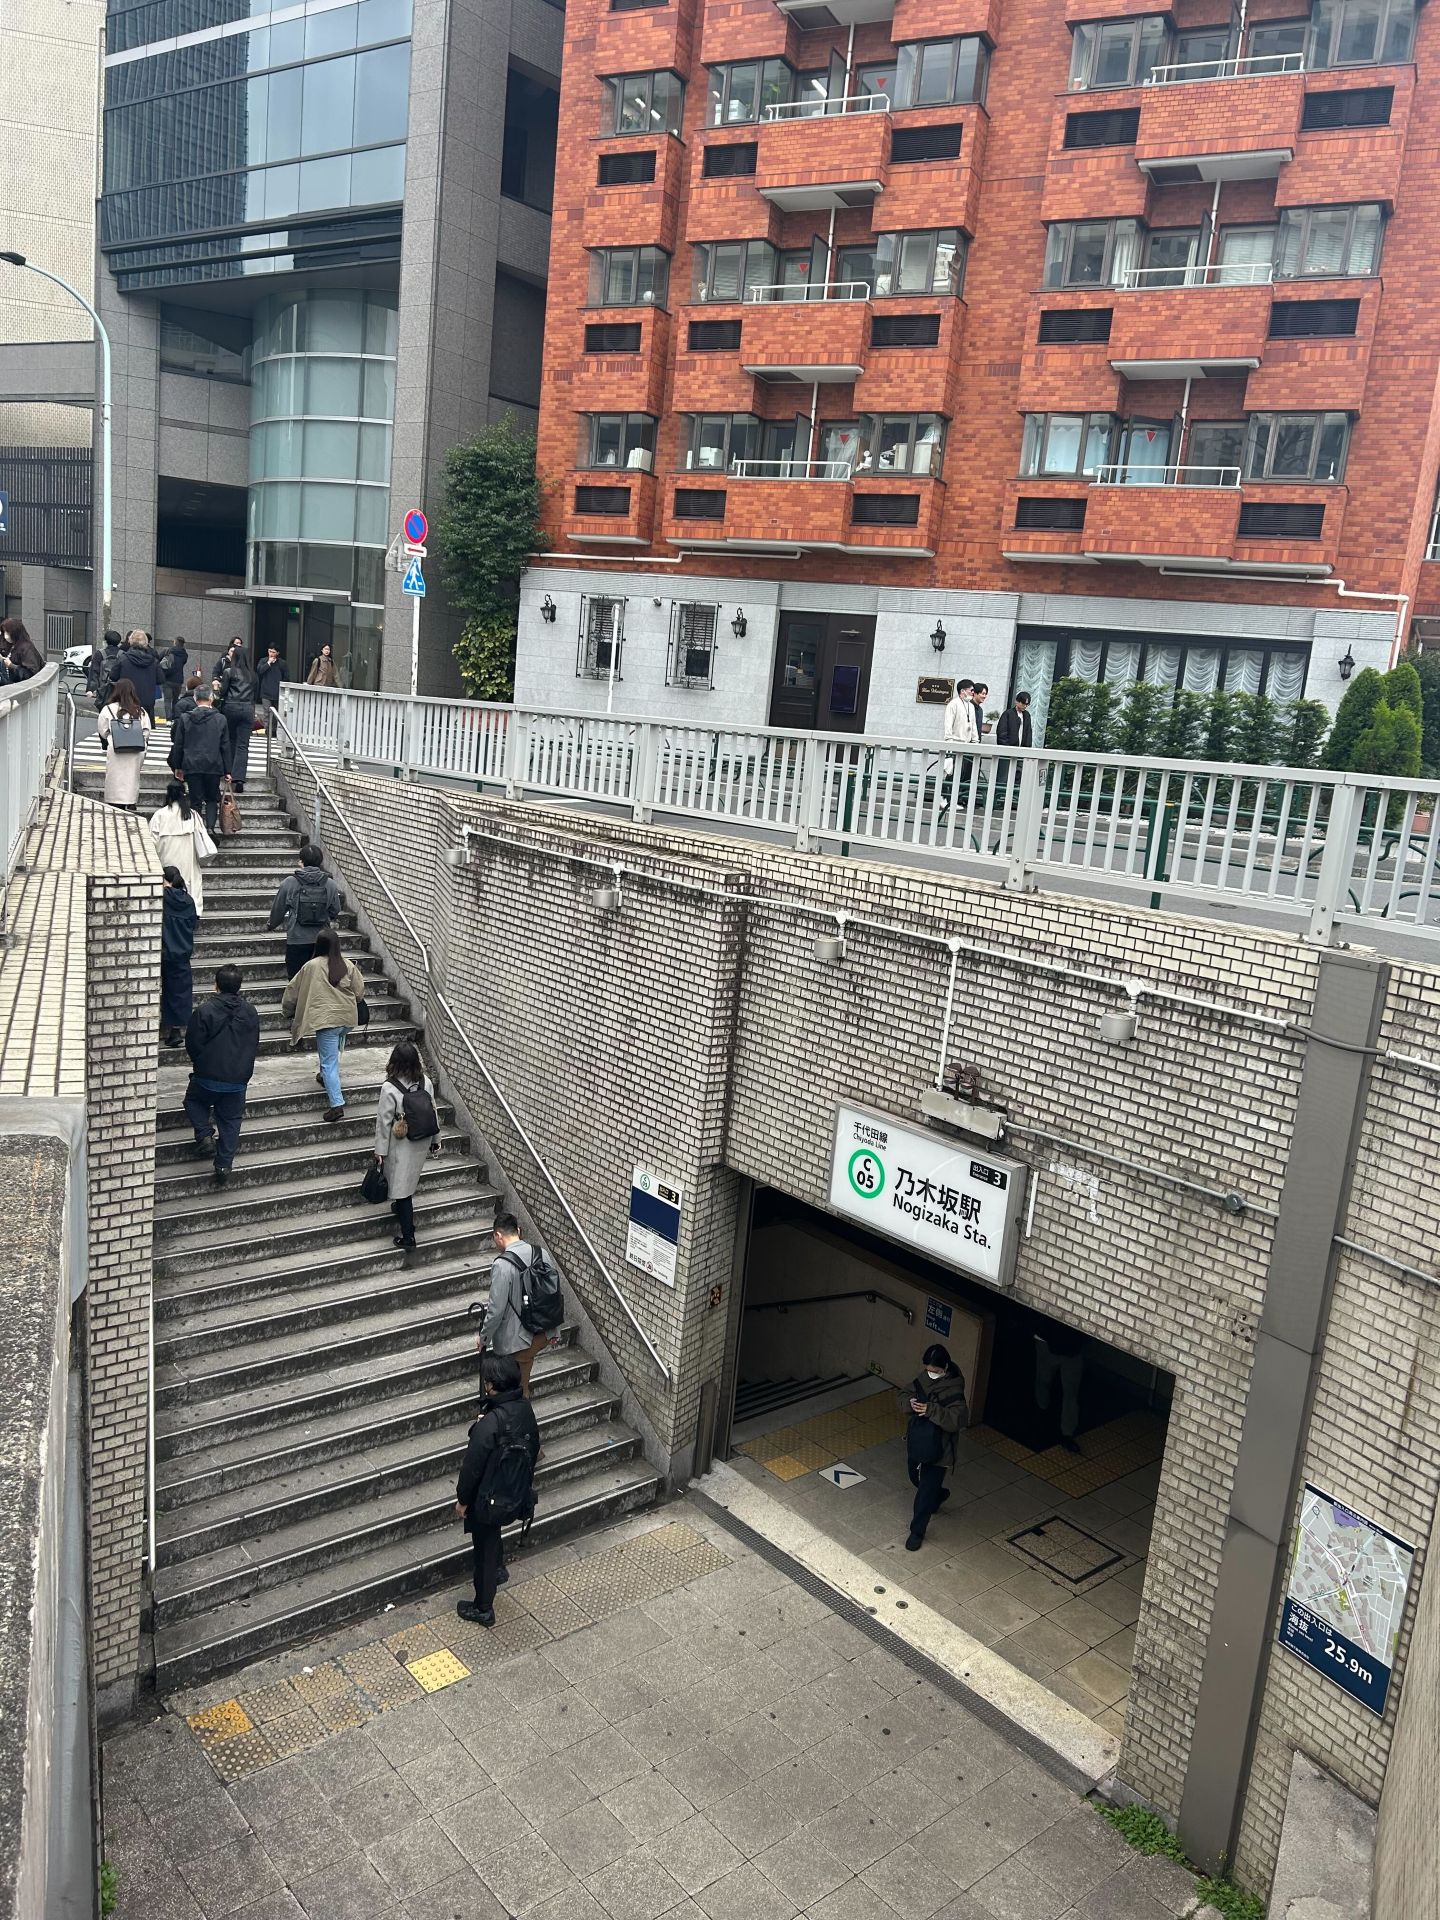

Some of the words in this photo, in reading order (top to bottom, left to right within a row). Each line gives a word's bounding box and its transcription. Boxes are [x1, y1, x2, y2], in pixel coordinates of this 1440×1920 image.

[853, 1121, 888, 1144] 千代田線
[853, 1133, 874, 1147] Chiyoda
[876, 1142, 887, 1151] Line
[863, 1158, 872, 1172] C
[972, 1165, 989, 1176] 出入口
[993, 1172, 1002, 1186] 3
[856, 1171, 874, 1189] 05
[670, 1191, 677, 1202] 3
[894, 1167, 982, 1225] 乃木坂駅
[893, 1193, 959, 1235] Nogizaka
[964, 1224, 992, 1249] Sta.
[926, 1319, 938, 1330] Left
[1288, 1612, 1309, 1634] 海抜
[1291, 1604, 1333, 1637] この出入口は
[1324, 1638, 1373, 1685] 25.9m
